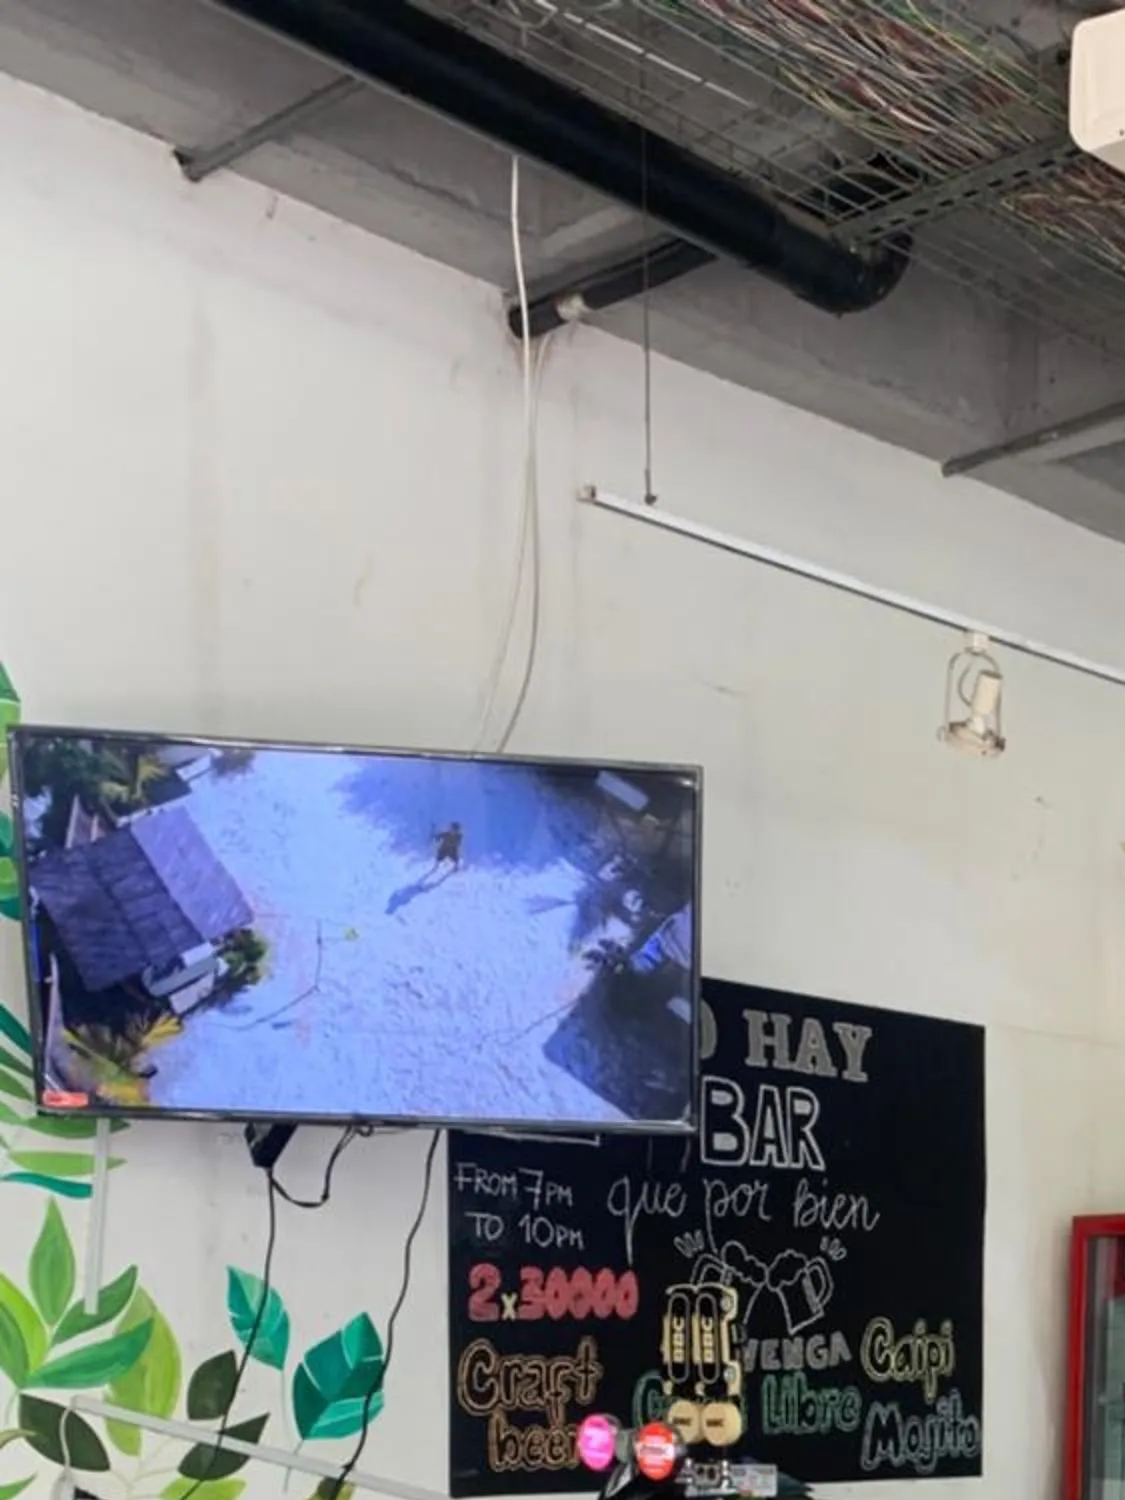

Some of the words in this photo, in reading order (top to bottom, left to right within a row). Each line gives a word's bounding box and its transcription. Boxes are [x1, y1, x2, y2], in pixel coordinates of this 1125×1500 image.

[742, 1008, 872, 1082] HAY
[700, 1075, 825, 1171] BAR
[453, 1161, 518, 1200] FROM
[464, 1211, 504, 1241] TO
[518, 1213, 585, 1250] 10PM
[606, 1175, 688, 1267] que
[702, 1178, 772, 1254] por
[793, 1176, 880, 1231] bien
[457, 1335, 604, 1429] Craft
[743, 1331, 852, 1373] VENGA
